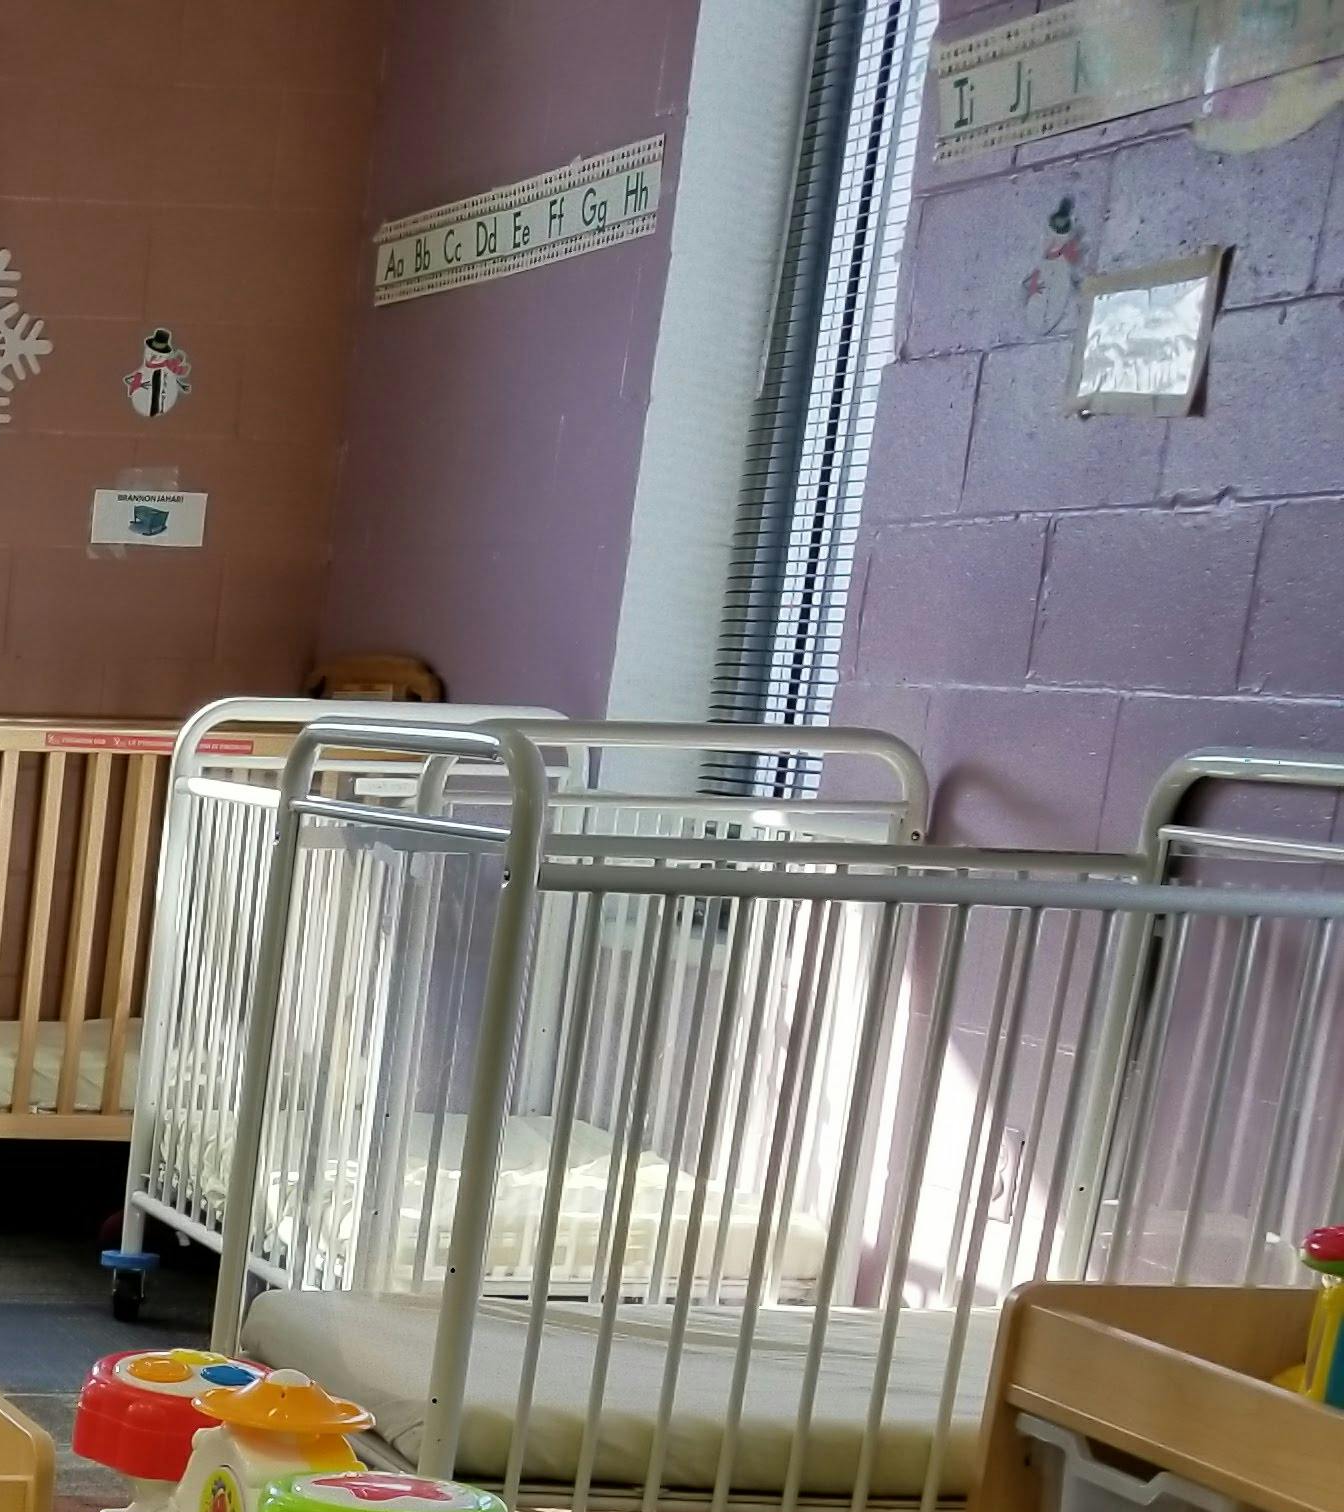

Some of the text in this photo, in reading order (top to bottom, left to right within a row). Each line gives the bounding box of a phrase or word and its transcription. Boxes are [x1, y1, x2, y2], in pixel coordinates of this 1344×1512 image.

[1009, 61, 1033, 123] Jj
[384, 171, 649, 281] Aa Bb Cc Dd Ee Ff Gg Hh
